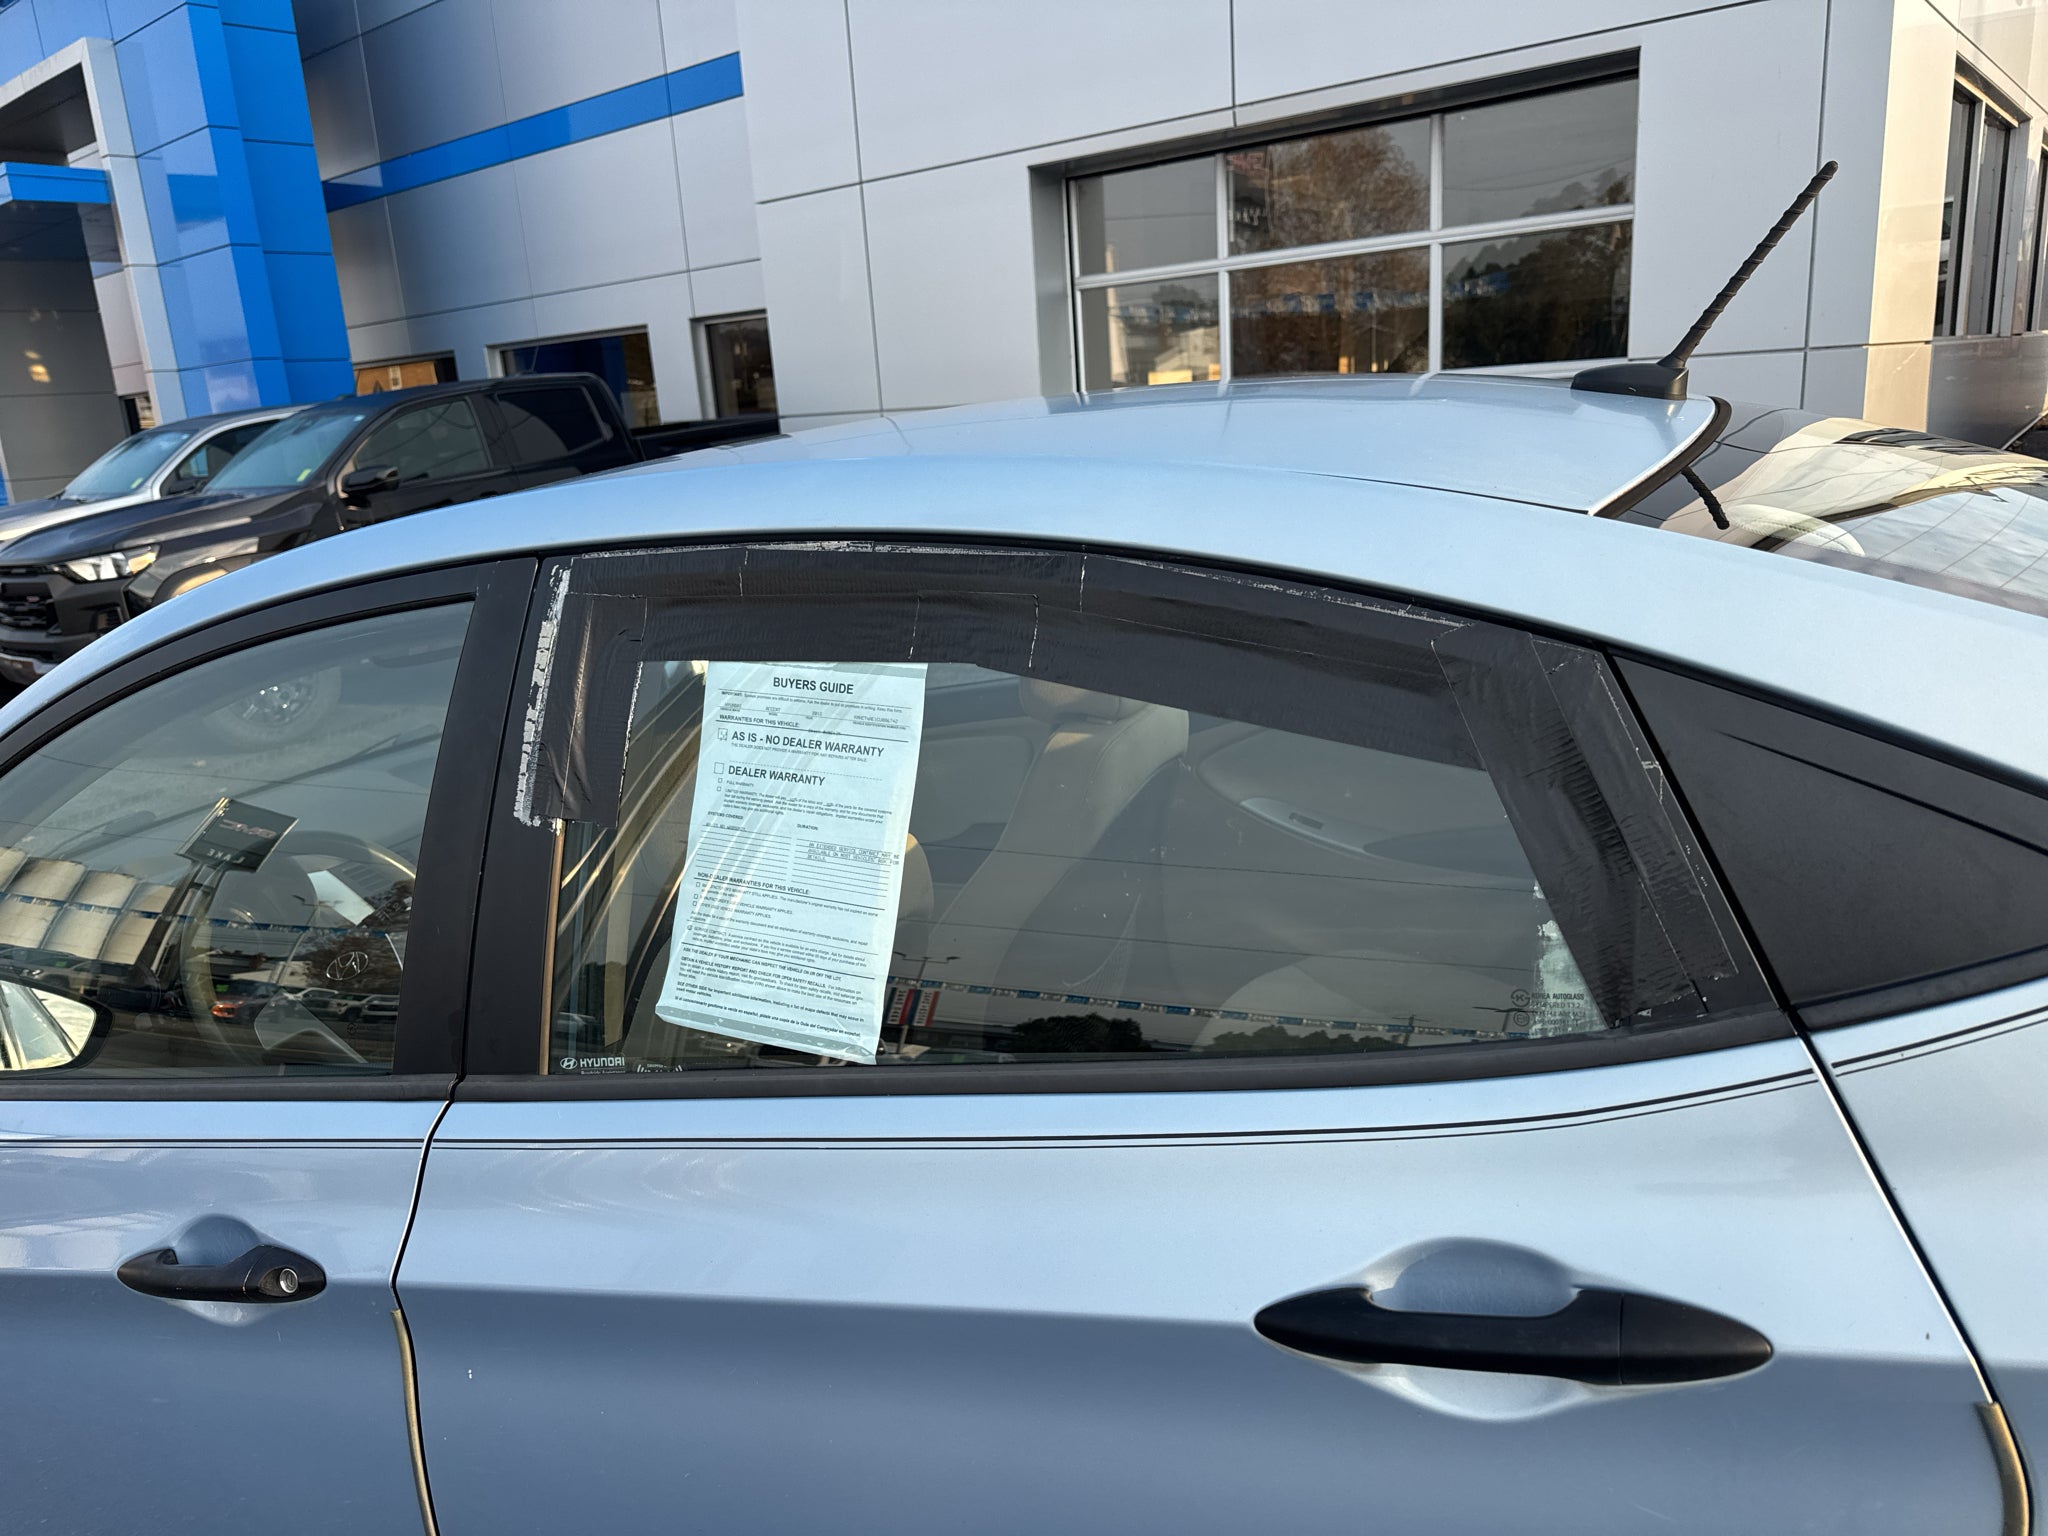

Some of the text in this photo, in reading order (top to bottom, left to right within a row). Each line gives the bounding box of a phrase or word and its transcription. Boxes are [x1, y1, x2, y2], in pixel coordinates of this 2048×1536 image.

[772, 676, 854, 695] BUYERS GUIDE
[719, 714, 752, 722] WARRANTIES
[731, 730, 746, 742] AS
[747, 732, 757, 743] IS
[764, 734, 780, 746] NO
[781, 736, 822, 750] DEALER
[823, 741, 884, 758] WARRANTY
[727, 765, 825, 786] DEALER WARRANTY
[1552, 993, 1585, 1001] AUTOGLASS
[579, 1057, 625, 1068] HYUNDAI
